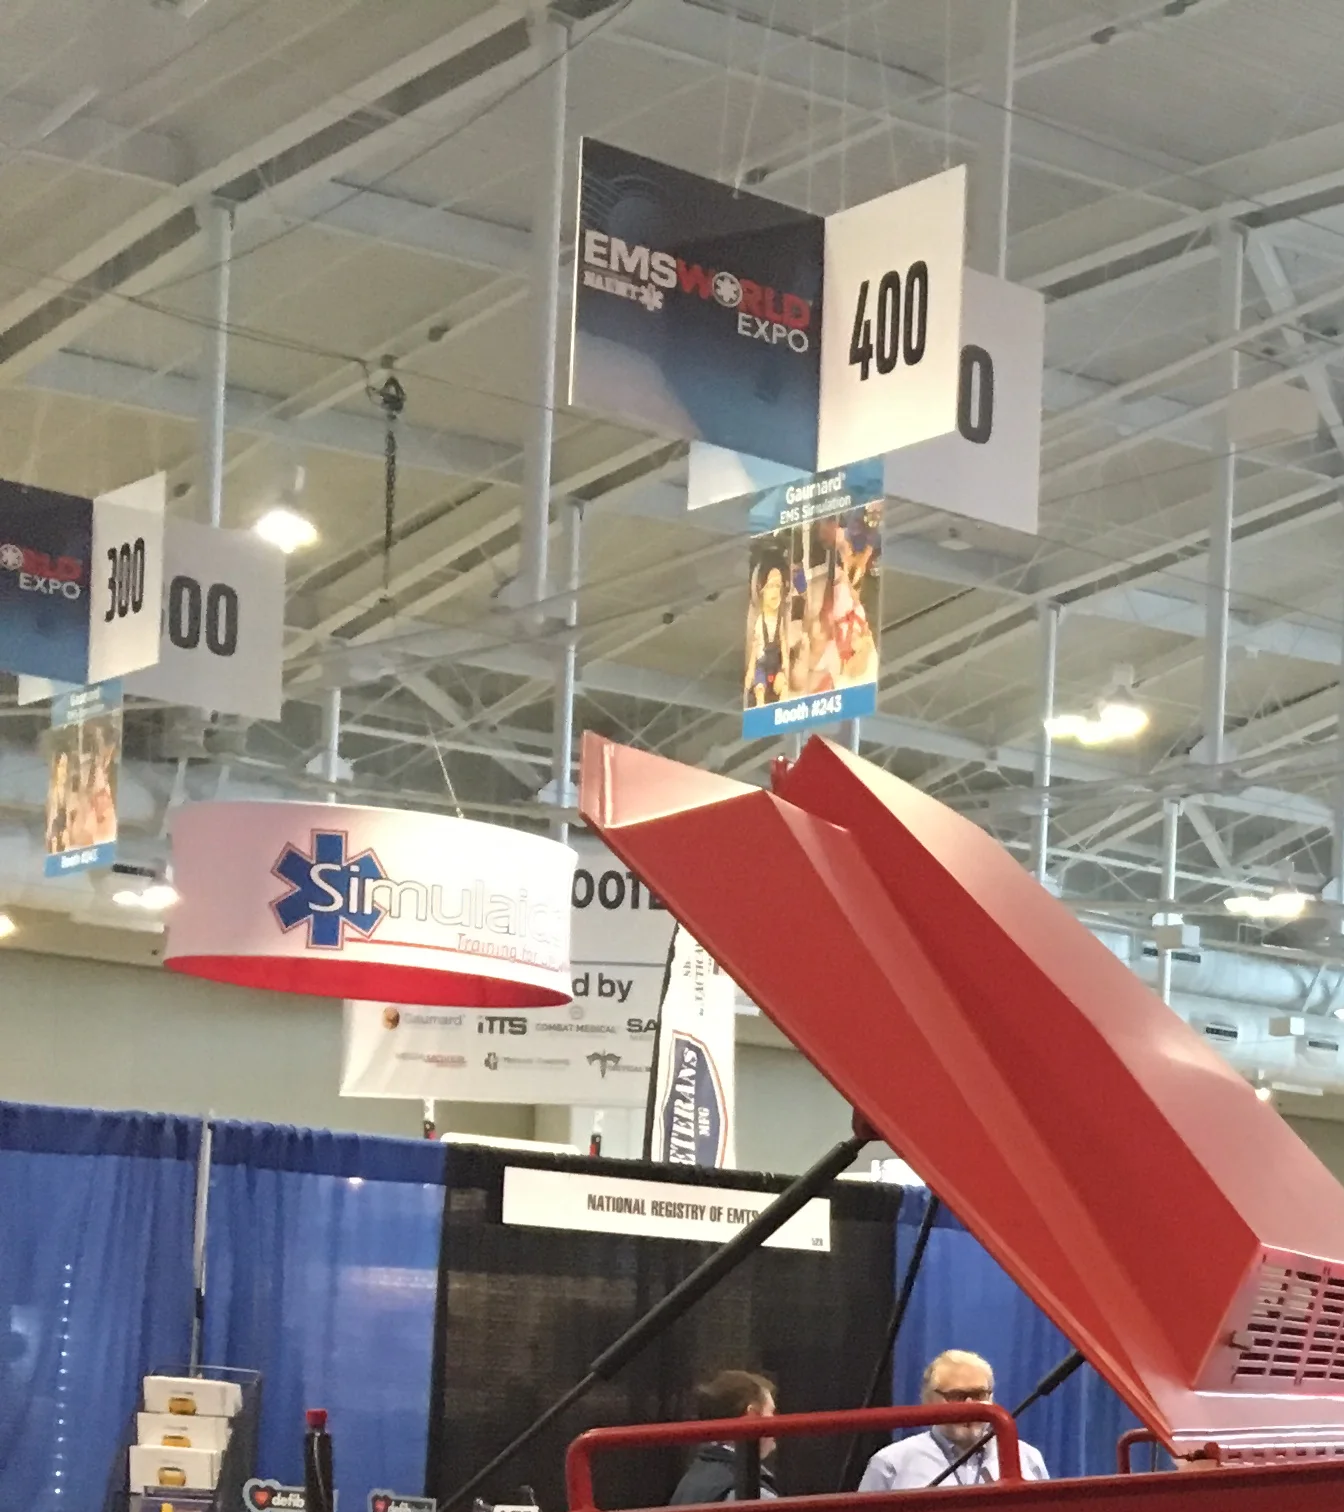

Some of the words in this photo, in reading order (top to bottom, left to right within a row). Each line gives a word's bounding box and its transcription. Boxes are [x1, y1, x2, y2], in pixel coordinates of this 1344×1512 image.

[737, 312, 809, 352] EXPO
[849, 260, 928, 381] 400
[19, 572, 81, 600] EXPO
[104, 536, 145, 622] 300
[163, 575, 239, 657] 00
[457, 933, 517, 965] Training
[598, 972, 633, 1003] by
[587, 1194, 646, 1216] NATIONAL
[651, 1201, 706, 1222] REGISTRY
[709, 1207, 723, 1223] OF
[271, 1493, 305, 1509] defib
